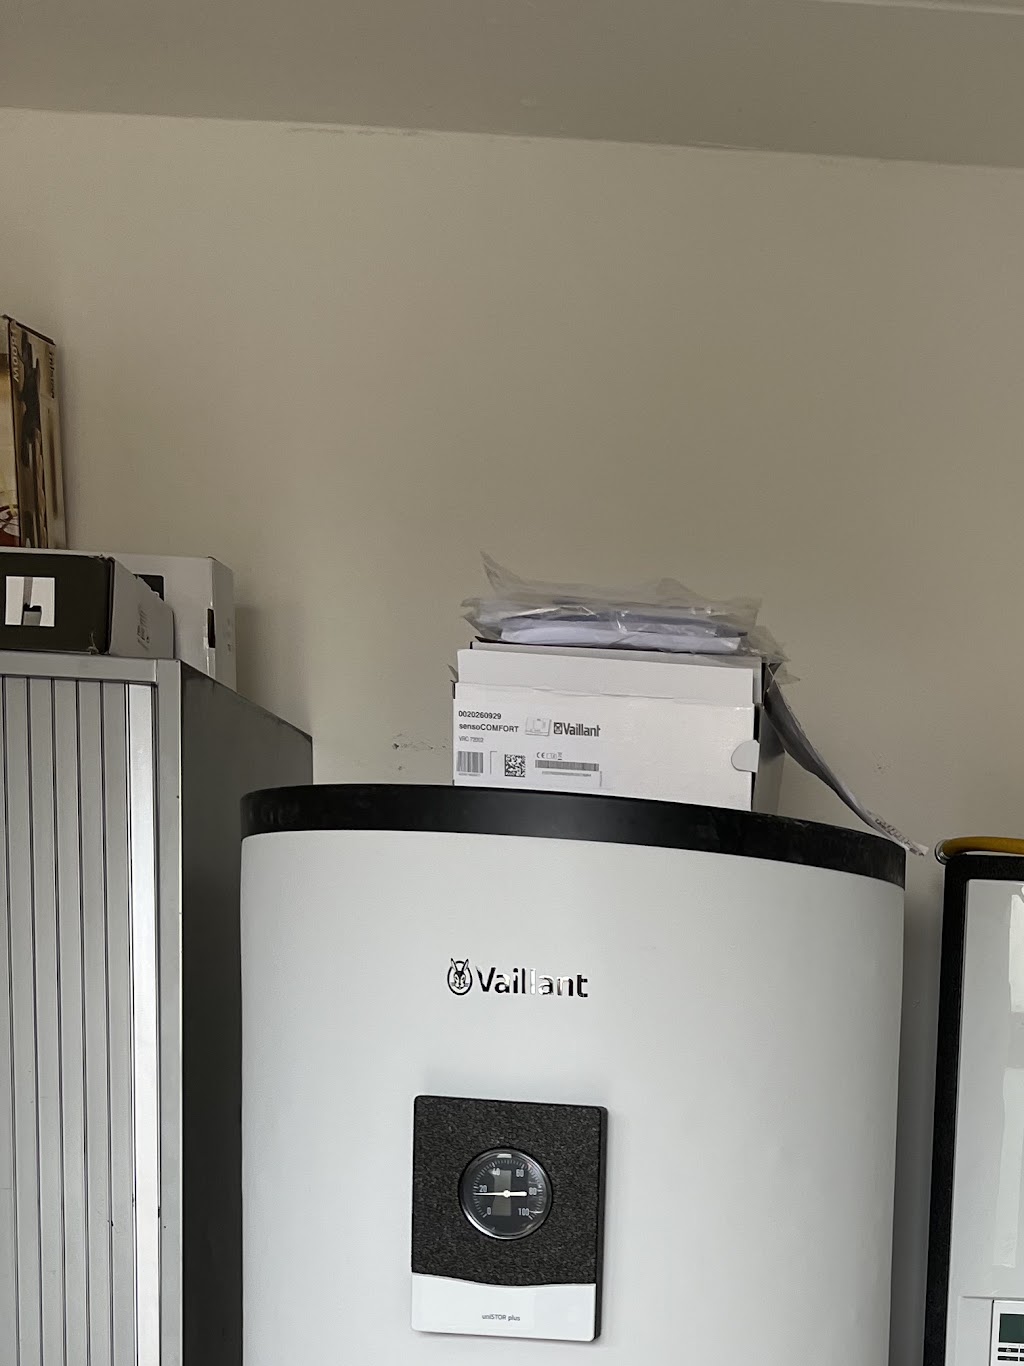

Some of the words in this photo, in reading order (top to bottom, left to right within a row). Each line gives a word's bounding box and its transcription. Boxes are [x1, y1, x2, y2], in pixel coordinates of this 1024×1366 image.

[458, 710, 502, 720] 0020260929
[459, 724, 519, 733] sensoCOMFORT
[563, 722, 601, 737] Vaillant
[475, 965, 589, 998] Vaillant
[492, 1167, 501, 1176] 40
[479, 1184, 488, 1193] 20
[486, 1206, 492, 1216] 0
[518, 1207, 530, 1217] 100
